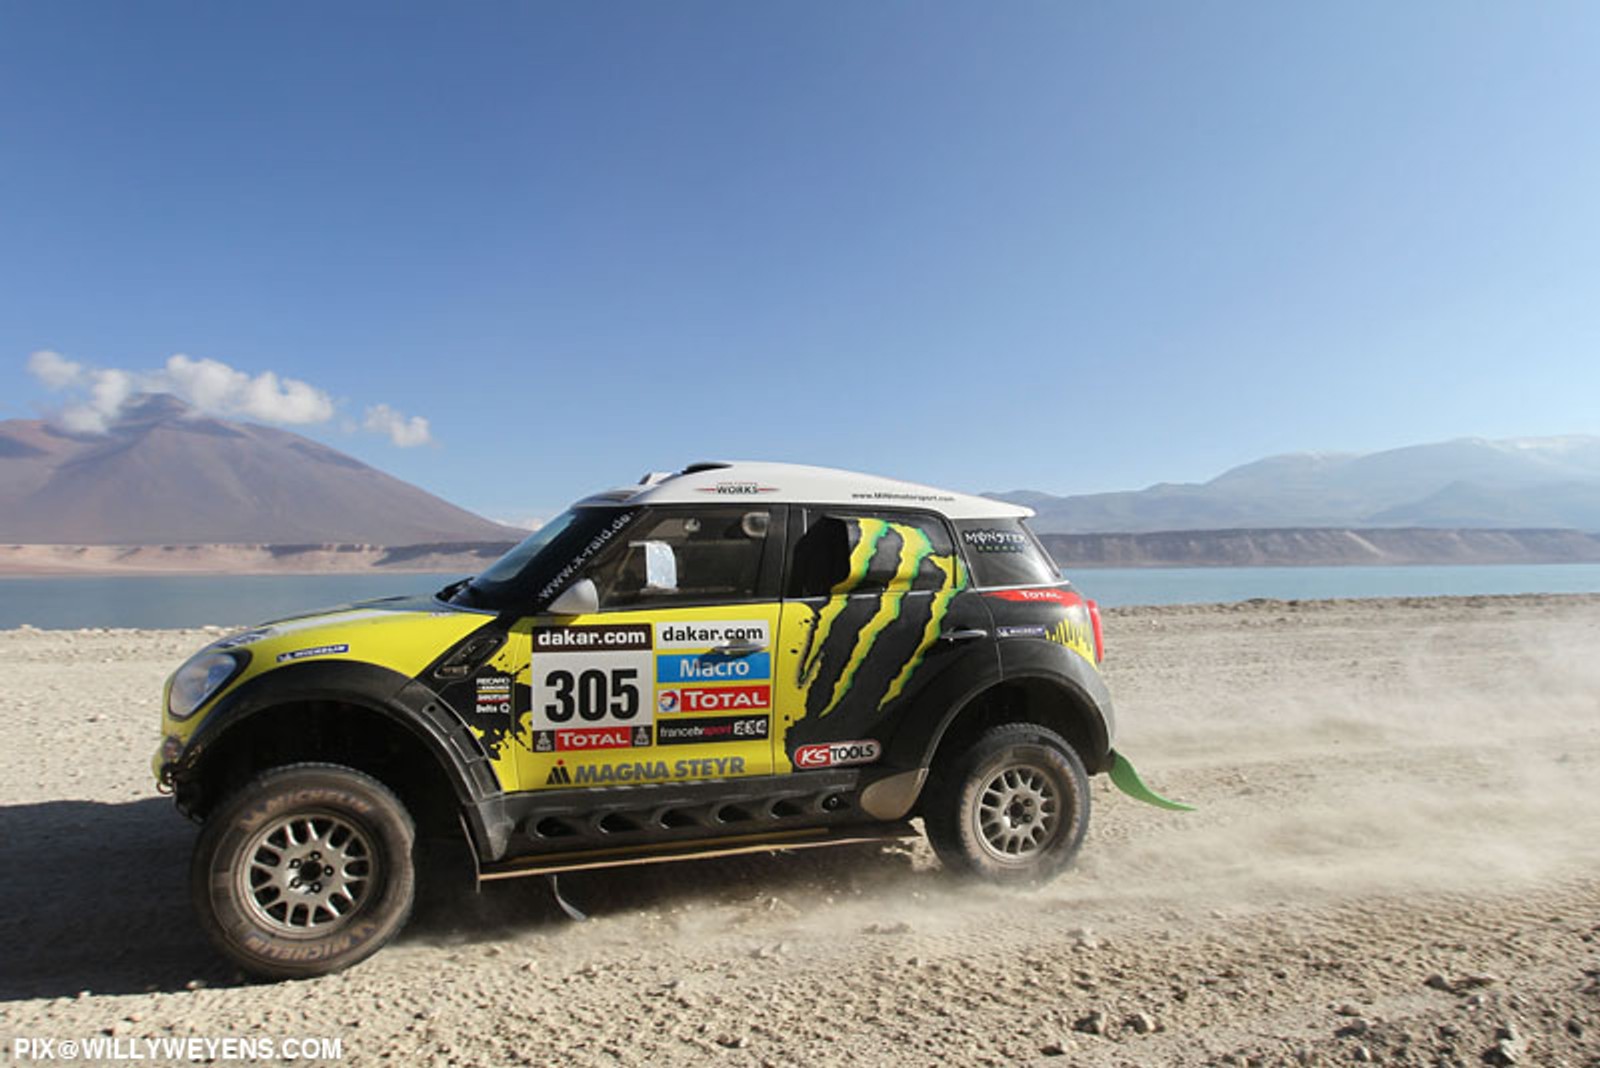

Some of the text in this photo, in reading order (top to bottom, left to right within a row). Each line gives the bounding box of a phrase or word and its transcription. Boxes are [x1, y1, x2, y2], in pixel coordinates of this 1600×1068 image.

[717, 485, 758, 495] WORKS
[538, 629, 646, 647] dakar.com
[662, 625, 763, 642] dakar.com
[680, 658, 750, 678] Macro
[545, 668, 640, 723] 305
[684, 689, 768, 709] TOTAL
[558, 731, 629, 747] TOTAL
[800, 744, 874, 765] KS TOOLS
[574, 756, 746, 784] MAGNA STEYR
